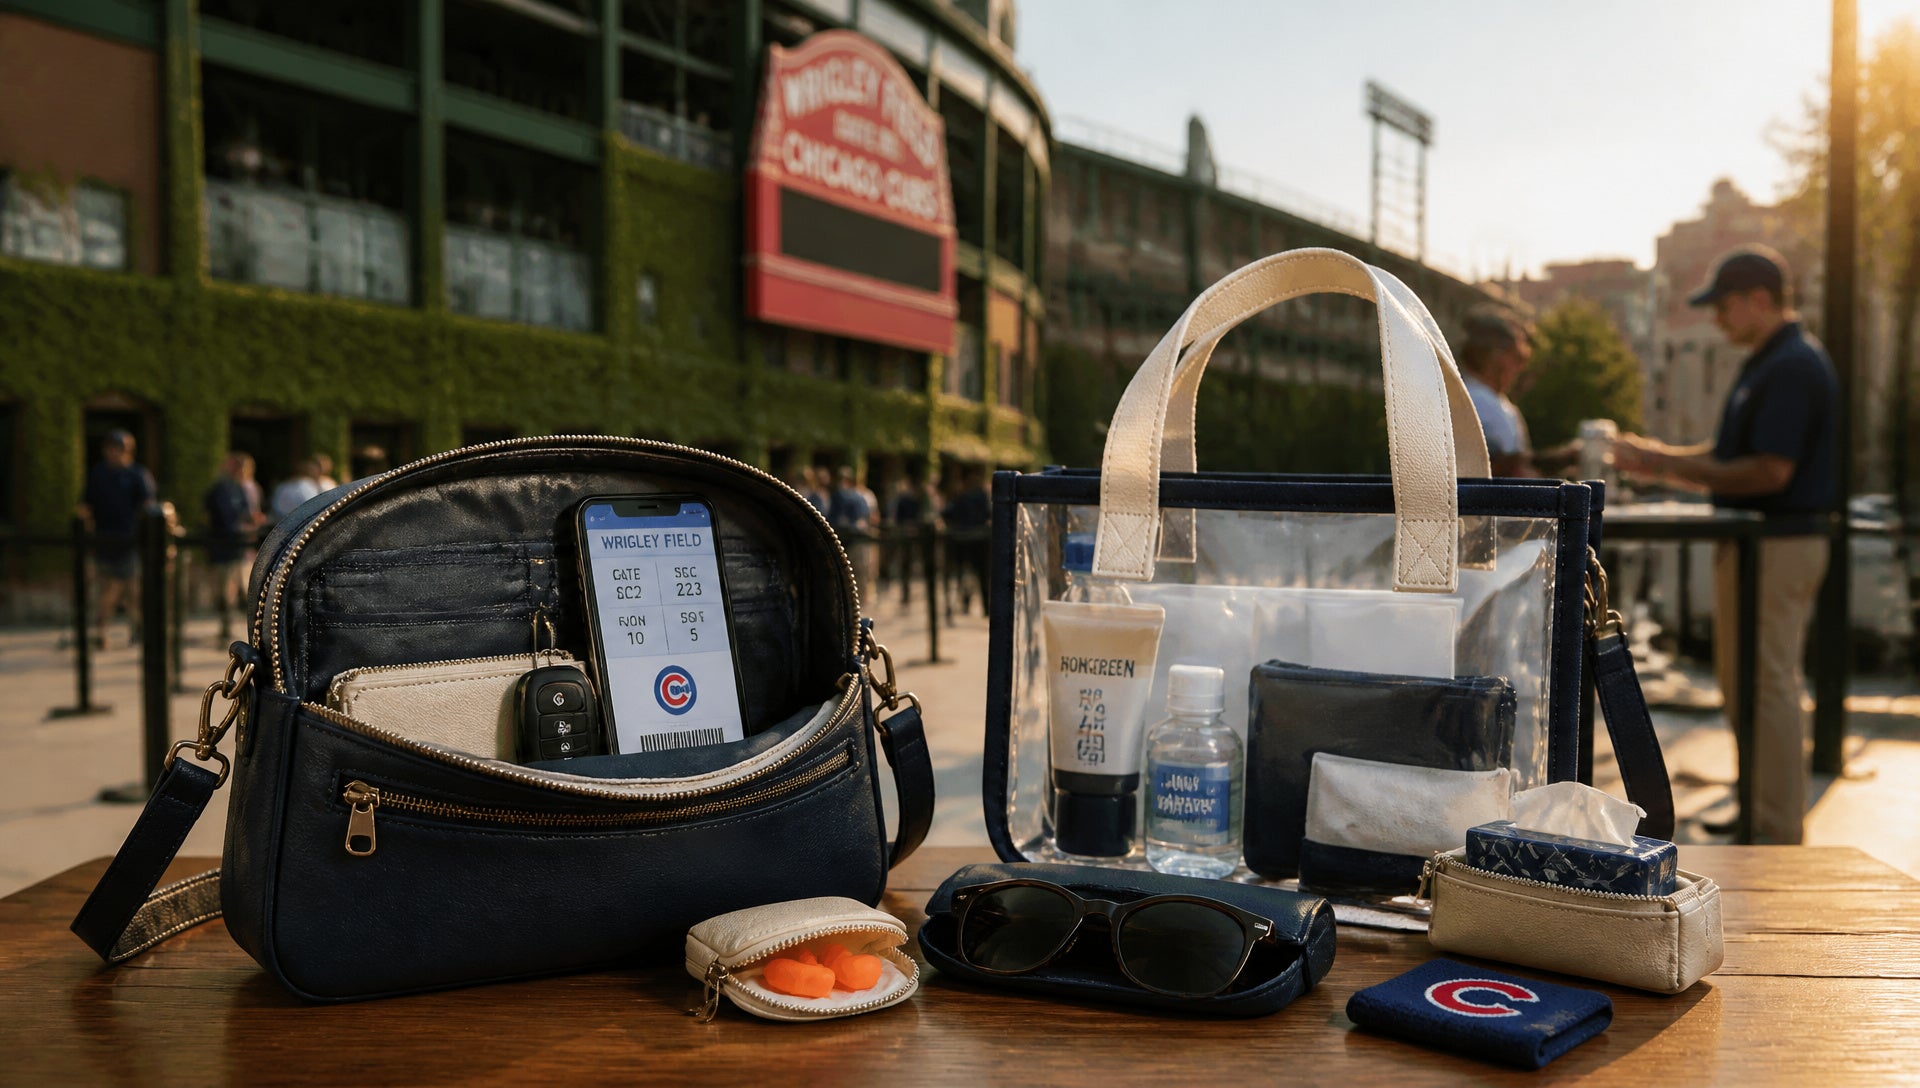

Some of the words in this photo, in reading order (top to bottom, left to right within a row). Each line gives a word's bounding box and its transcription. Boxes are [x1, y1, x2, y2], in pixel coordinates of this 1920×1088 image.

[601, 534, 659, 550] WRIGLEY
[663, 533, 702, 548] FIELD
[676, 582, 702, 597] 223
[627, 631, 645, 645] 10
[690, 627, 698, 642] 5
